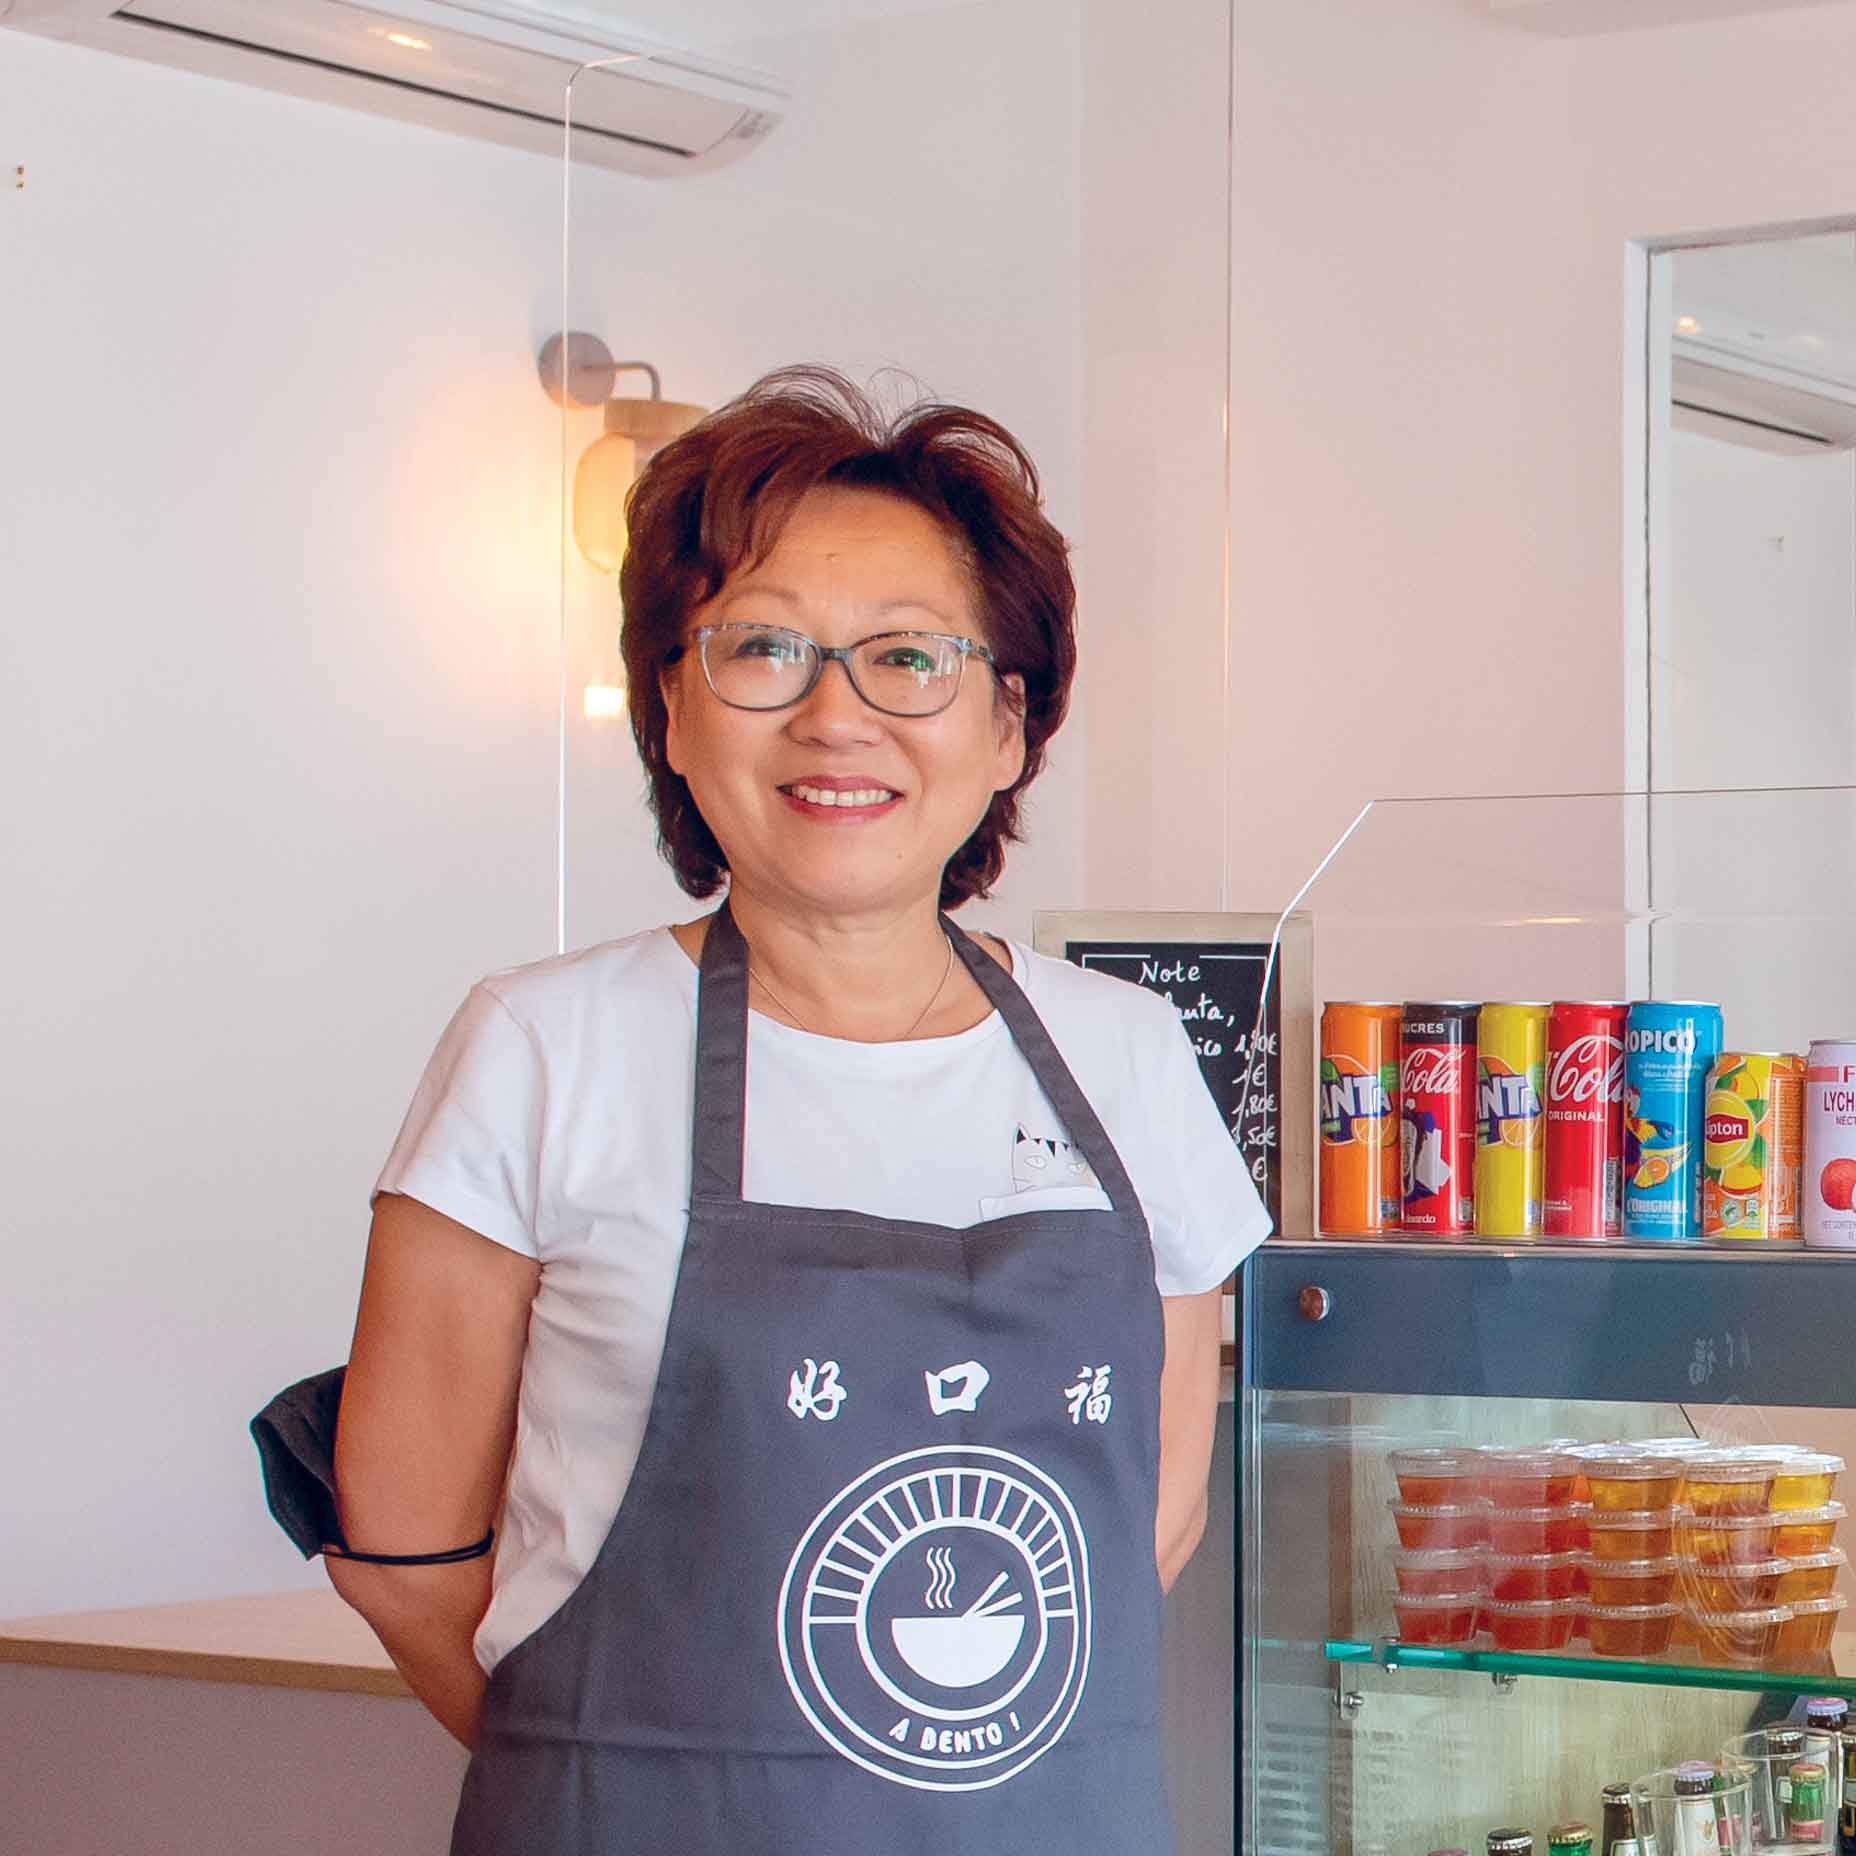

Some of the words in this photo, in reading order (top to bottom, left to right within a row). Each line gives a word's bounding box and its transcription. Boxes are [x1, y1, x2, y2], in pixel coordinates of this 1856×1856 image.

[1138, 961, 1200, 985] Note
[1404, 1022, 1445, 1034] UCRES
[1624, 1029, 1696, 1054] OPICO
[1548, 1110, 1605, 1122] ORIGINAL
[1706, 1120, 1744, 1138] ipton
